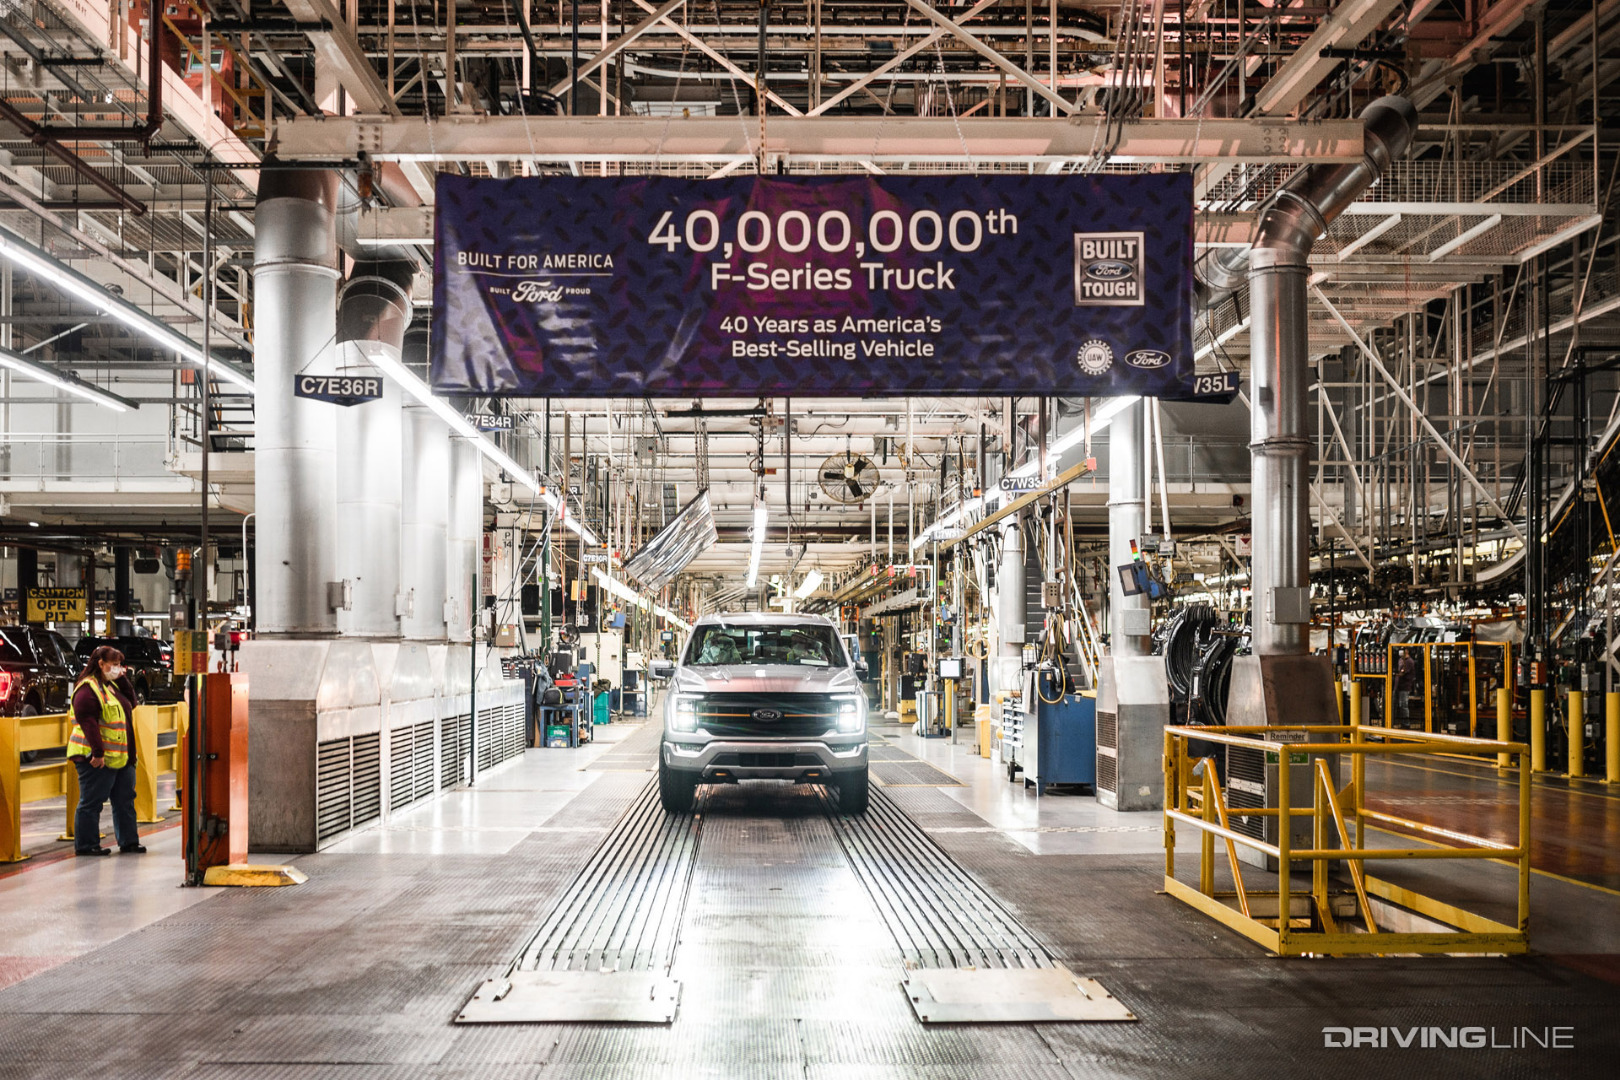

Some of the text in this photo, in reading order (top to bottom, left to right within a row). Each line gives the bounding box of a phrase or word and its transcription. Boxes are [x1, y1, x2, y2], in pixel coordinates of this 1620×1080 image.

[648, 208, 1018, 260] 40,000,000th
[1082, 240, 1137, 259] BUILT
[458, 251, 614, 269] BUILT FOR AMERICA
[711, 261, 956, 290] F-Series Truck
[1095, 264, 1123, 276] Ford
[490, 287, 511, 295] BUILT
[512, 280, 564, 303] Ford
[1083, 282, 1136, 297] TOUGH
[720, 316, 748, 333] 40
[753, 316, 809, 333] Years
[813, 319, 837, 333] as
[732, 339, 934, 360] Best-Selling Vehicle
[1087, 353, 1104, 362] UAW
[1133, 352, 1163, 366] Ford
[301, 377, 378, 396] C7E36R
[465, 414, 512, 428] C7E34R
[504, 531, 511, 539] P
[29, 588, 85, 598] CAUTION
[36, 600, 77, 610] OPEN
[45, 611, 69, 622] PIT
[1270, 732, 1305, 741] Reminder
